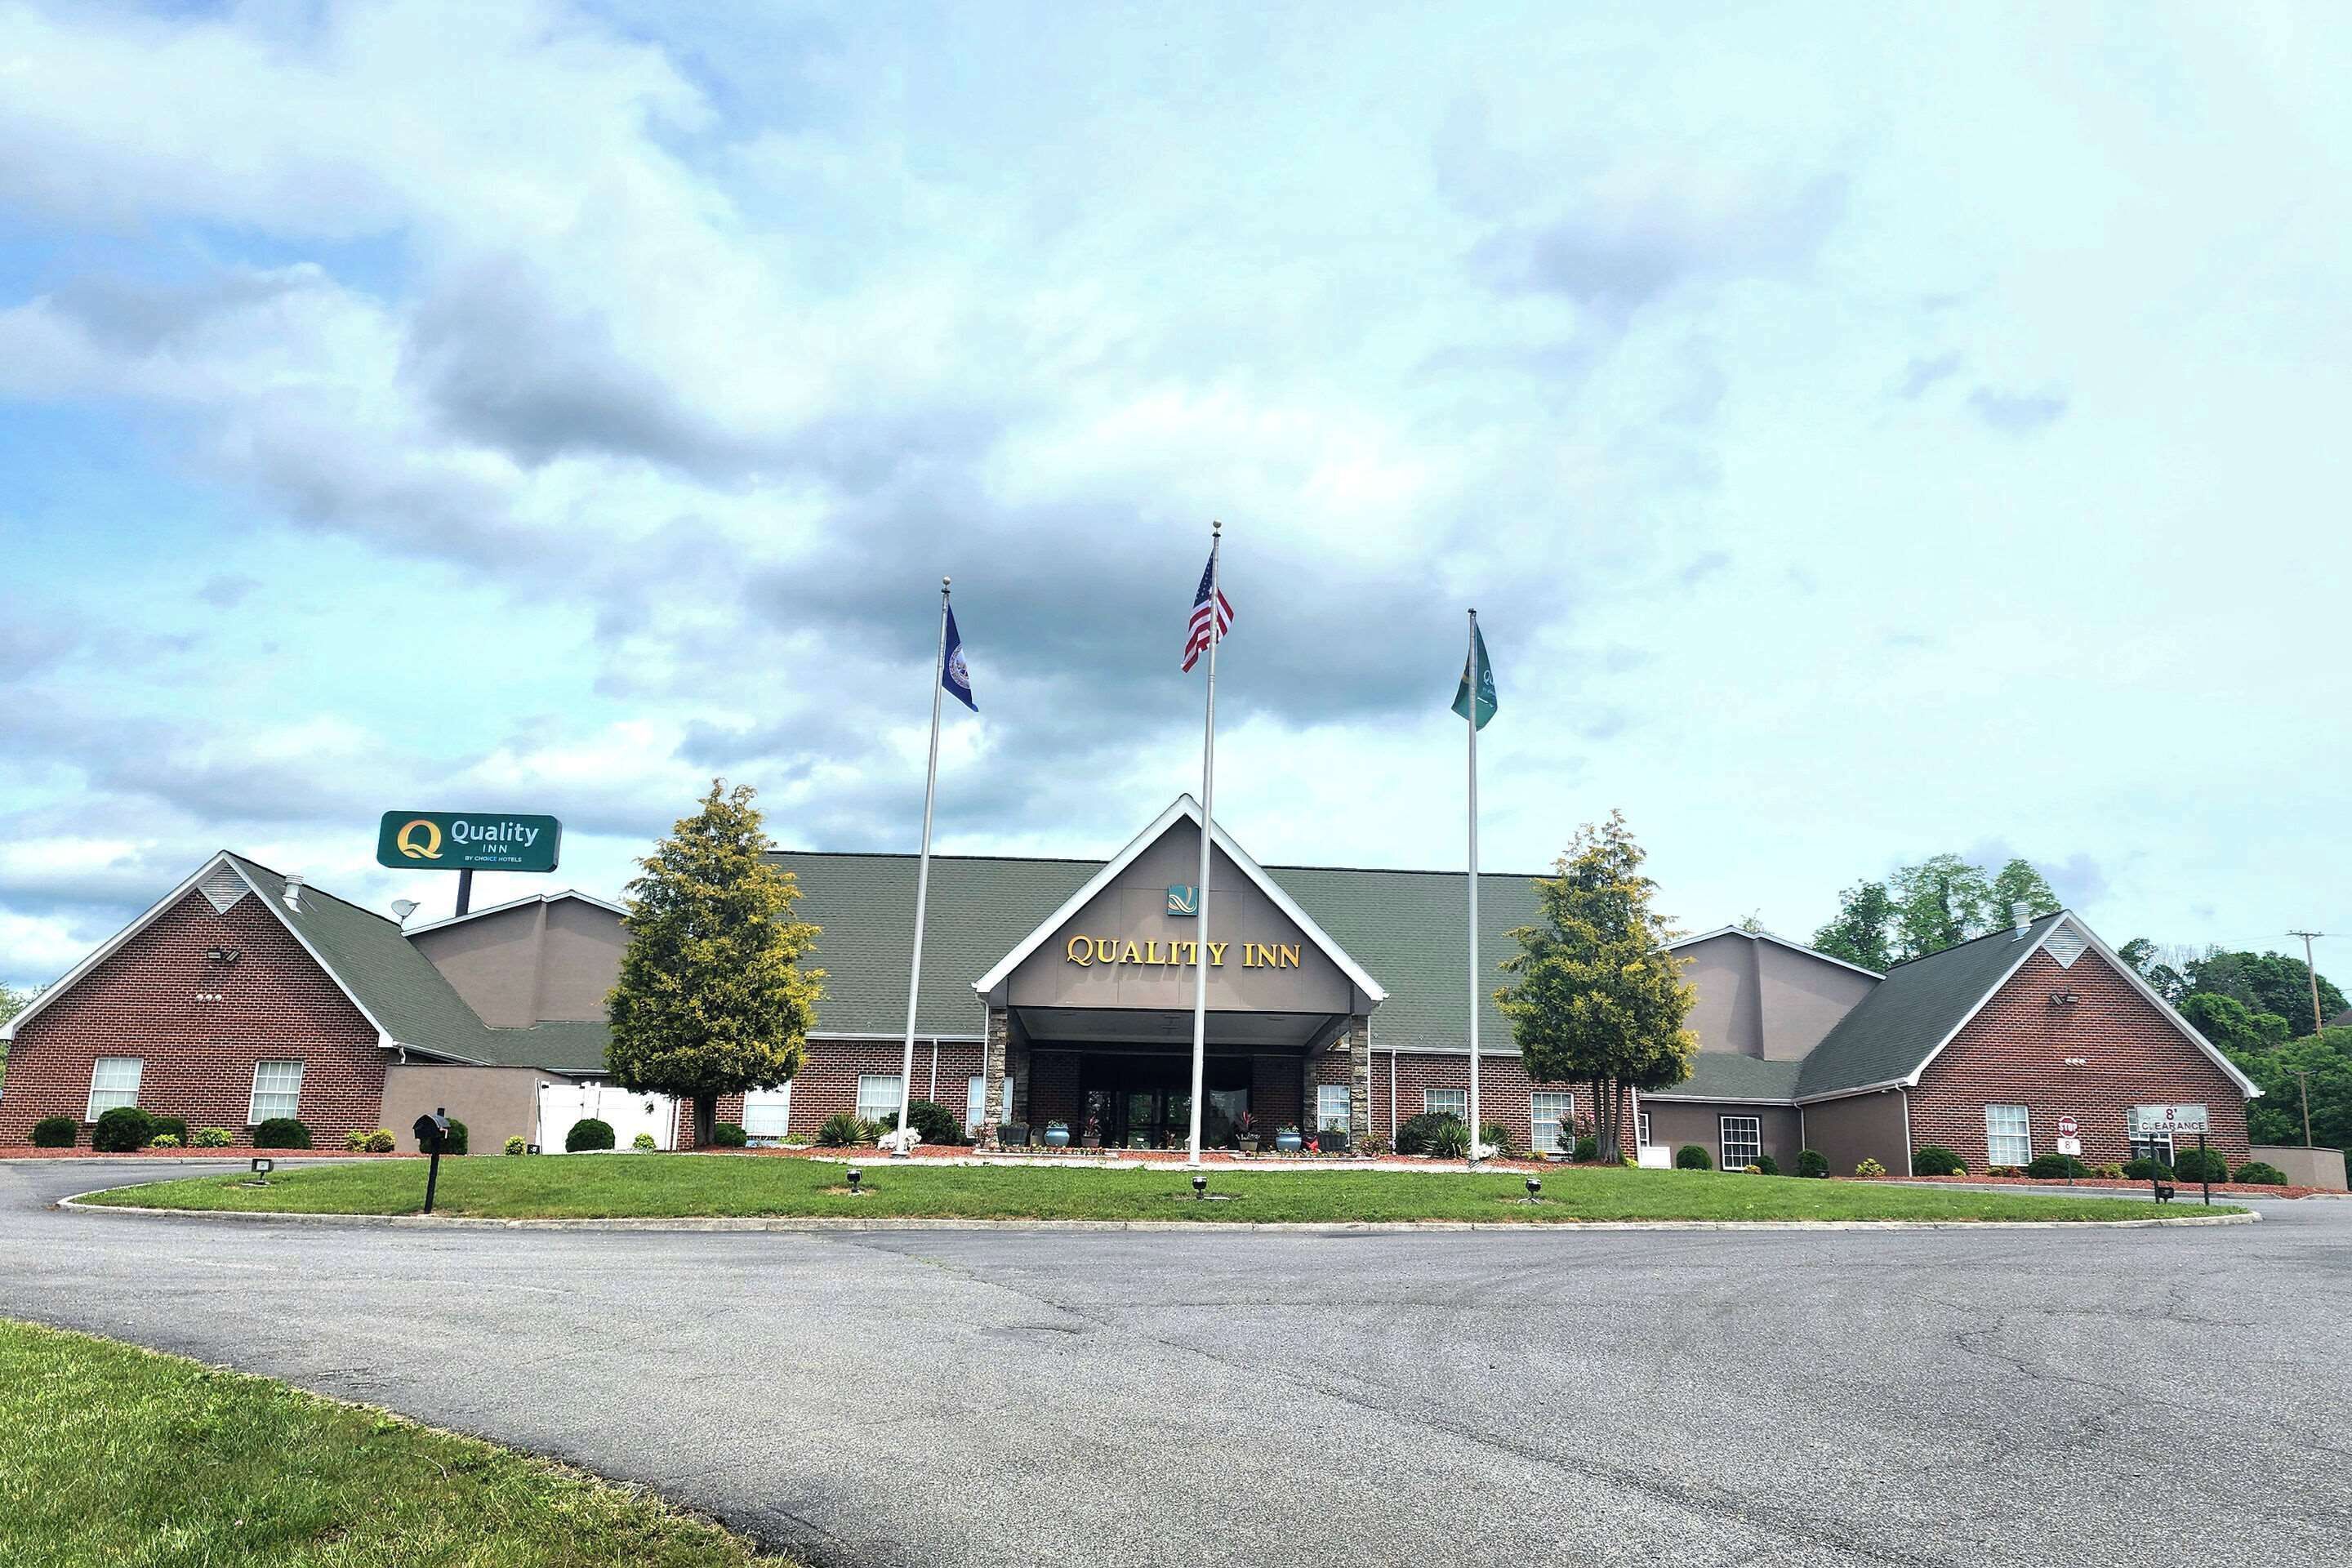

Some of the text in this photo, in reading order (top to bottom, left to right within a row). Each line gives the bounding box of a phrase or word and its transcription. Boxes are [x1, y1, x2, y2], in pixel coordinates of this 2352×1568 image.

[451, 820, 539, 847] Quality
[483, 844, 507, 853] INN
[1067, 934, 1300, 968] QUALITY INN
[2058, 1122, 2078, 1132] STOP
